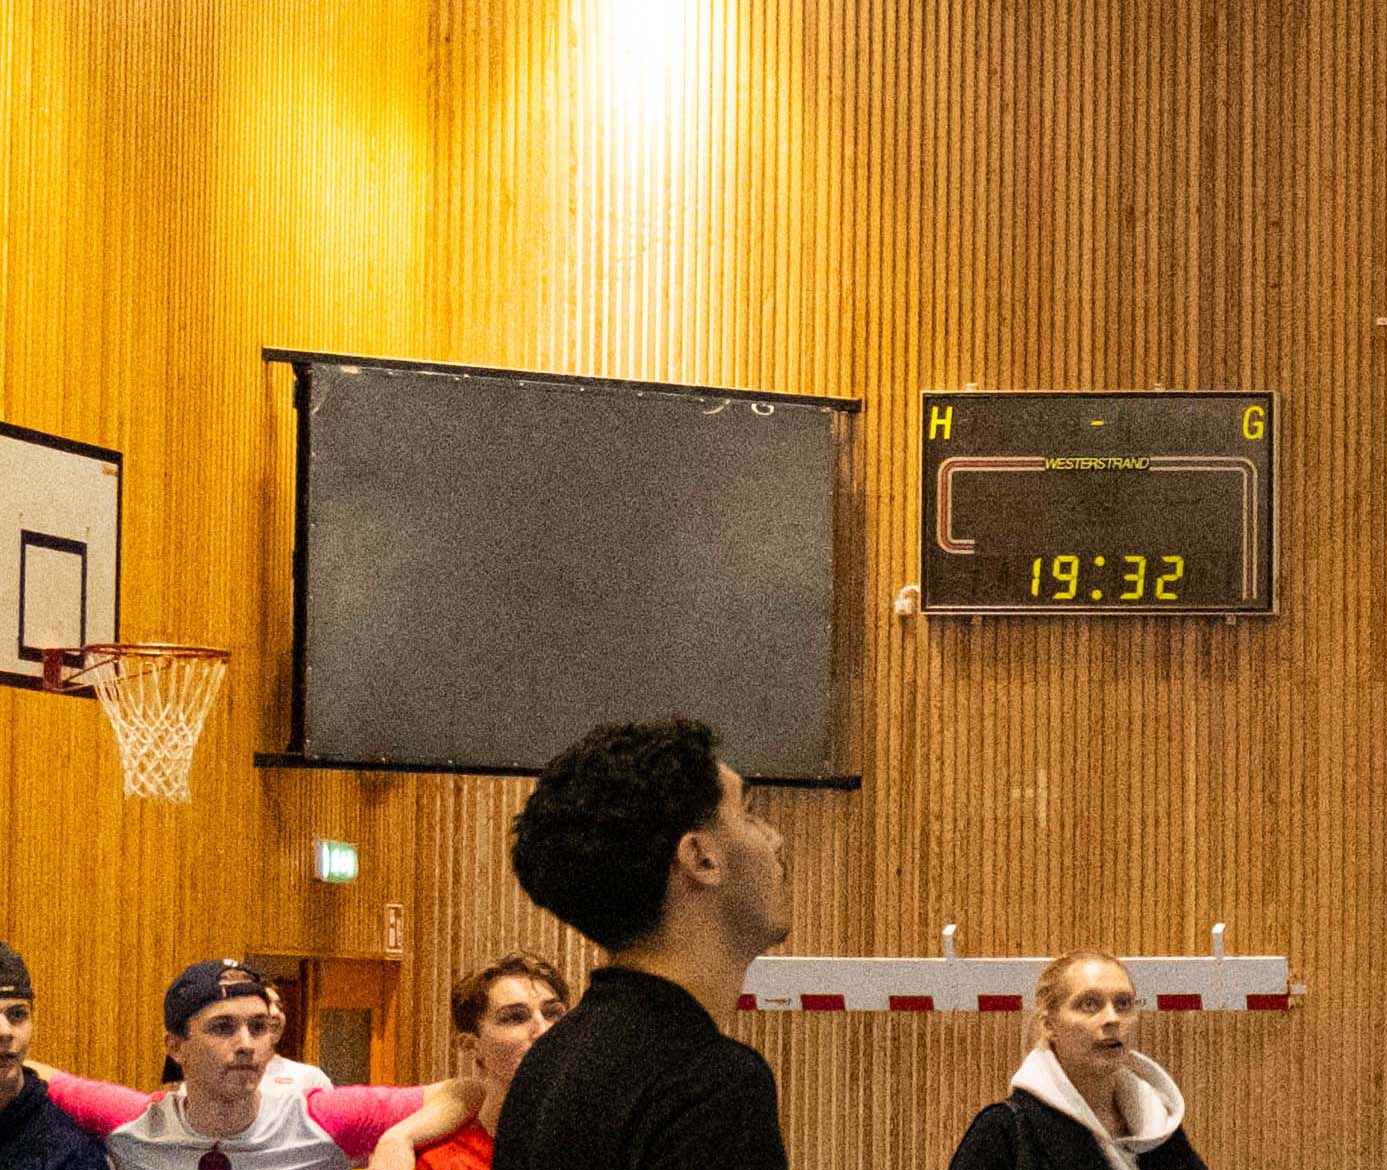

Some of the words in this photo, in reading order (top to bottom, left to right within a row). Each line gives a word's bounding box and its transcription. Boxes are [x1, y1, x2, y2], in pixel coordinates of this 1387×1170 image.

[929, 406, 953, 440] H
[1242, 405, 1266, 440] G
[1045, 457, 1151, 471] WESTERSTRAND
[1031, 554, 1185, 601] 19:32
